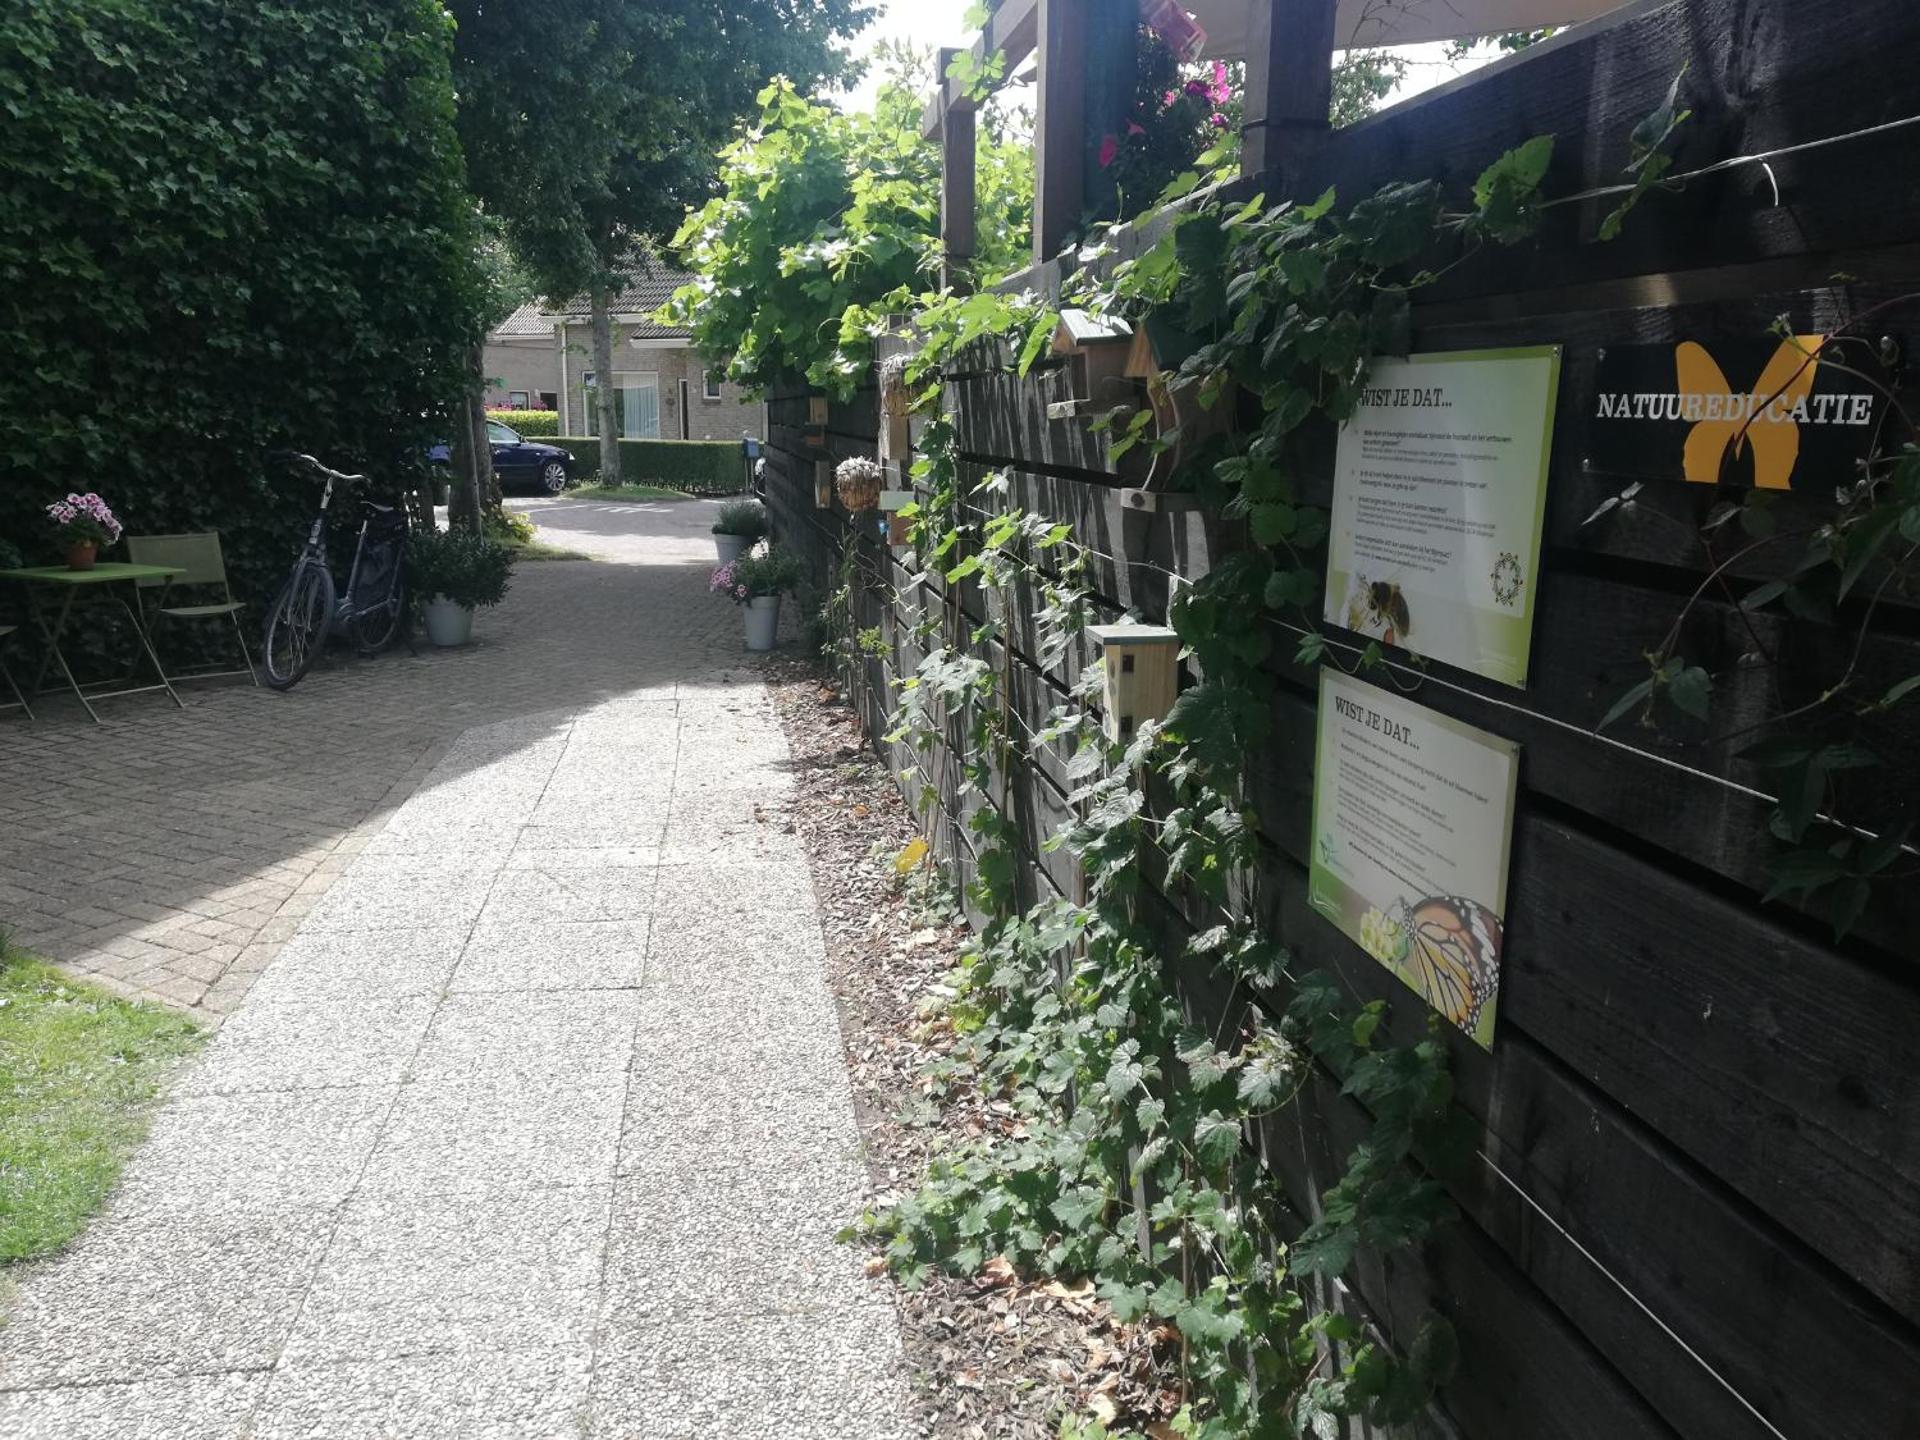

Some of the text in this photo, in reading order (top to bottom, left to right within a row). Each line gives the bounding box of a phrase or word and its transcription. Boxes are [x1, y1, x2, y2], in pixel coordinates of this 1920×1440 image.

[1361, 388, 1452, 408] WIST JE DAT...
[1335, 696, 1420, 750] WIST JE DAT...
